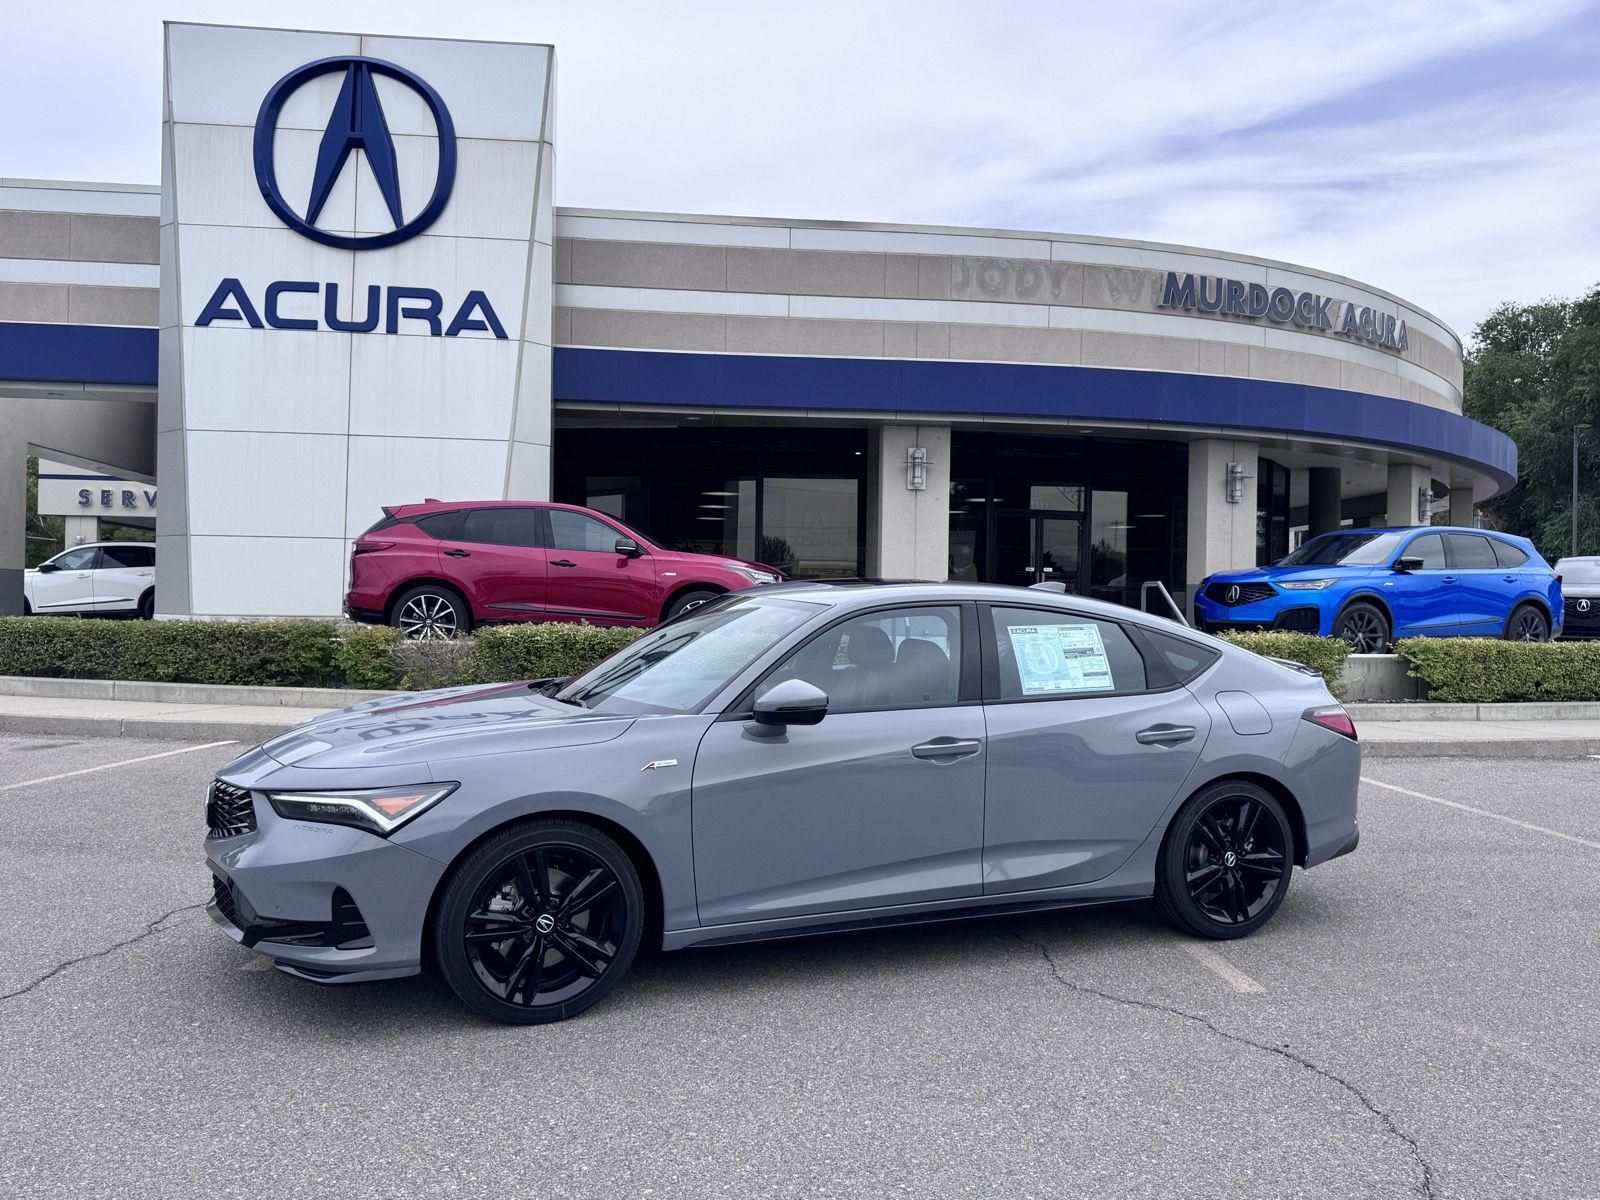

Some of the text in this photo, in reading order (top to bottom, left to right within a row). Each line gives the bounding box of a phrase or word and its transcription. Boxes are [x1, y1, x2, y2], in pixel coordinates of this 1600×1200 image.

[953, 258, 1069, 298] JODY
[194, 277, 508, 339] ACURA
[1160, 271, 1409, 351] MURDOCK ACURA
[78, 489, 157, 508] SERV
